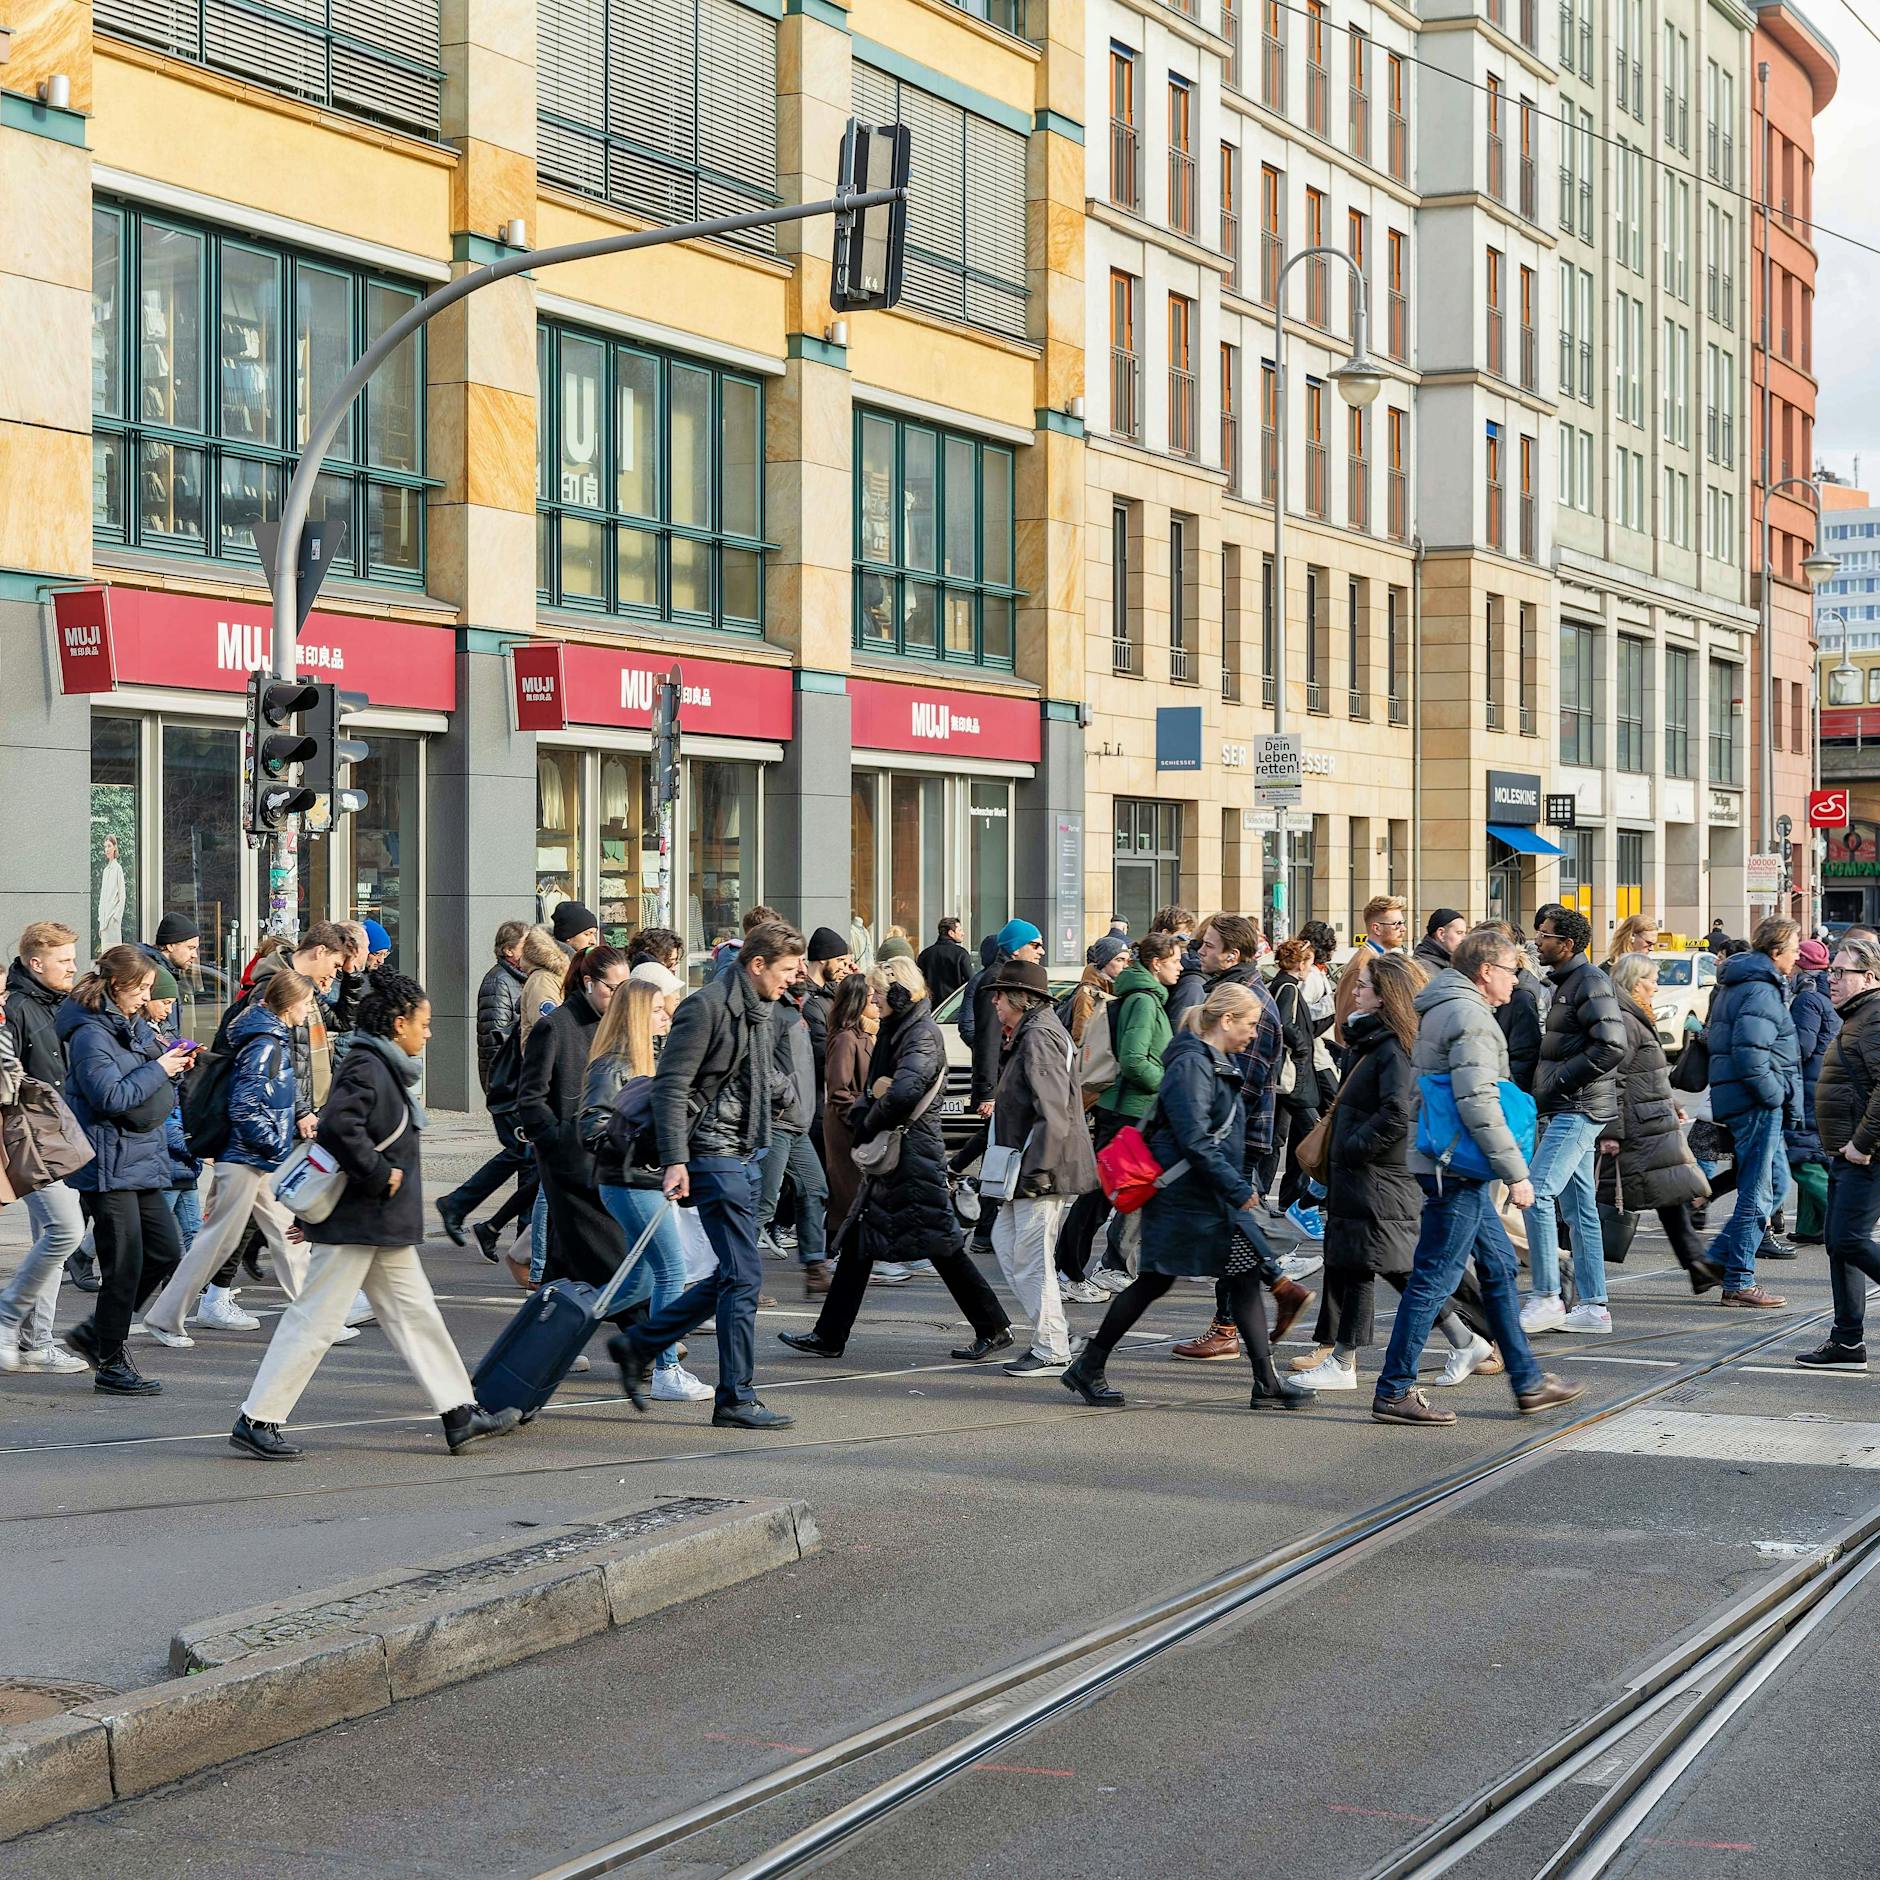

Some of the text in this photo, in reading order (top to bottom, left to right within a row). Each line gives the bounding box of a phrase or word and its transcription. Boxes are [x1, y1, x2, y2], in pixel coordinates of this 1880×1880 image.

[64, 626, 101, 647] MUJI
[217, 621, 273, 672] MUJ
[521, 676, 554, 693] MUJI
[680, 686, 711, 707] 印良品
[912, 701, 949, 739] MUJI
[1265, 741, 1290, 751] Dein
[1258, 751, 1297, 763] Leben
[1256, 761, 1300, 775] retten!
[1494, 786, 1537, 806] MOLESKINE
[985, 817, 990, 829] 1
